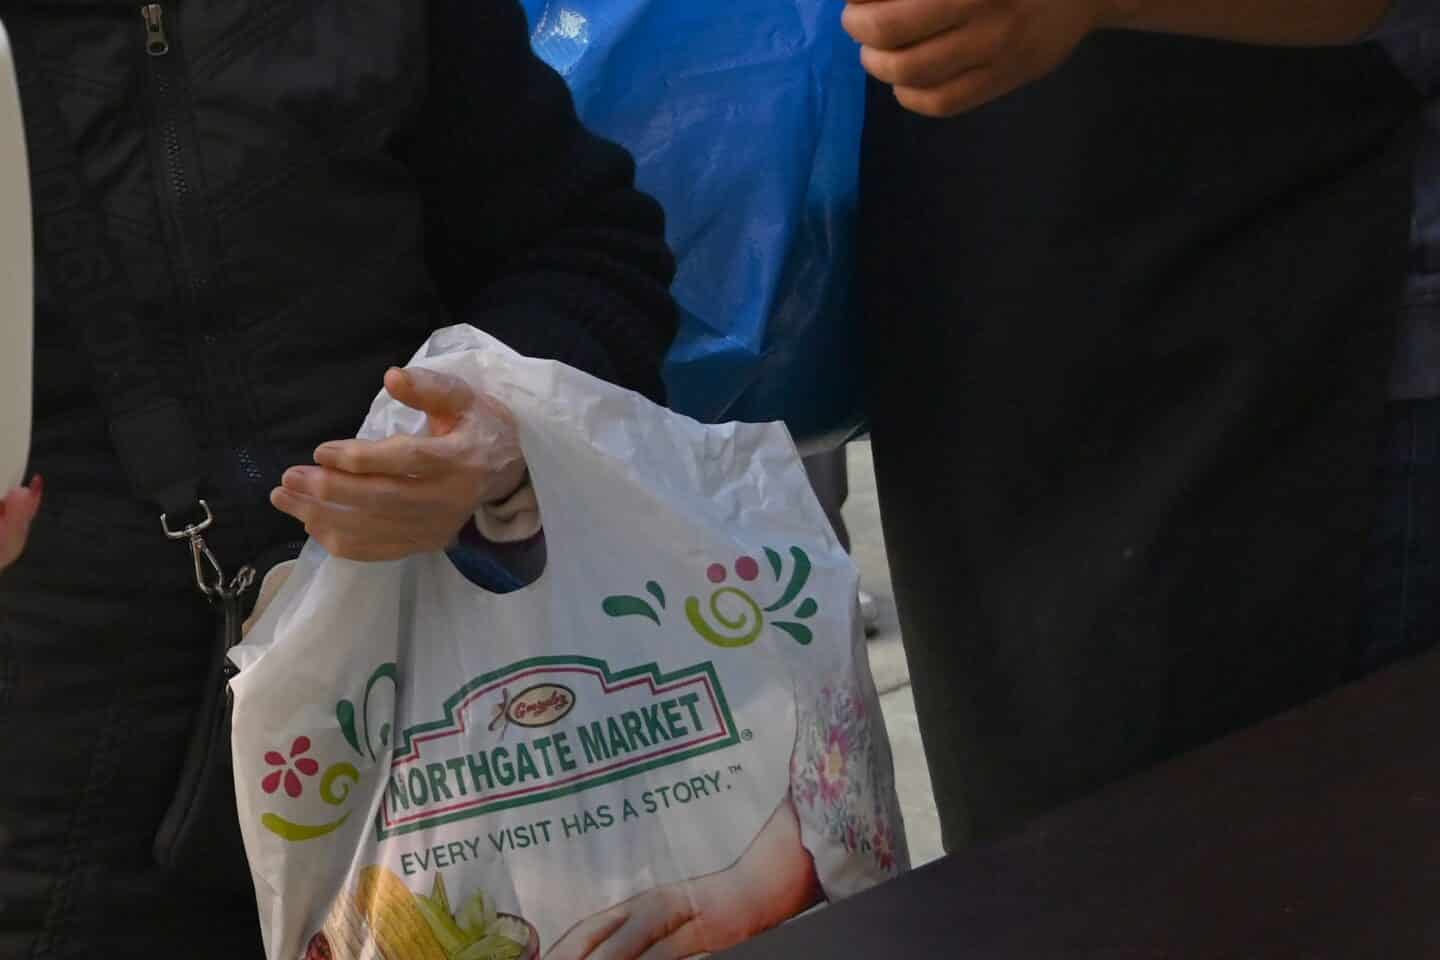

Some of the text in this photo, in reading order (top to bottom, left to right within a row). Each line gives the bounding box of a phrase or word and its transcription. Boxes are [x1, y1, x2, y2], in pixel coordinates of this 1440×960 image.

[389, 692, 704, 813] NORTHGATE MARKET
[400, 836, 480, 876] EVERY
[488, 820, 552, 853] VISIT
[561, 805, 615, 839] HAS
[623, 798, 639, 822] A
